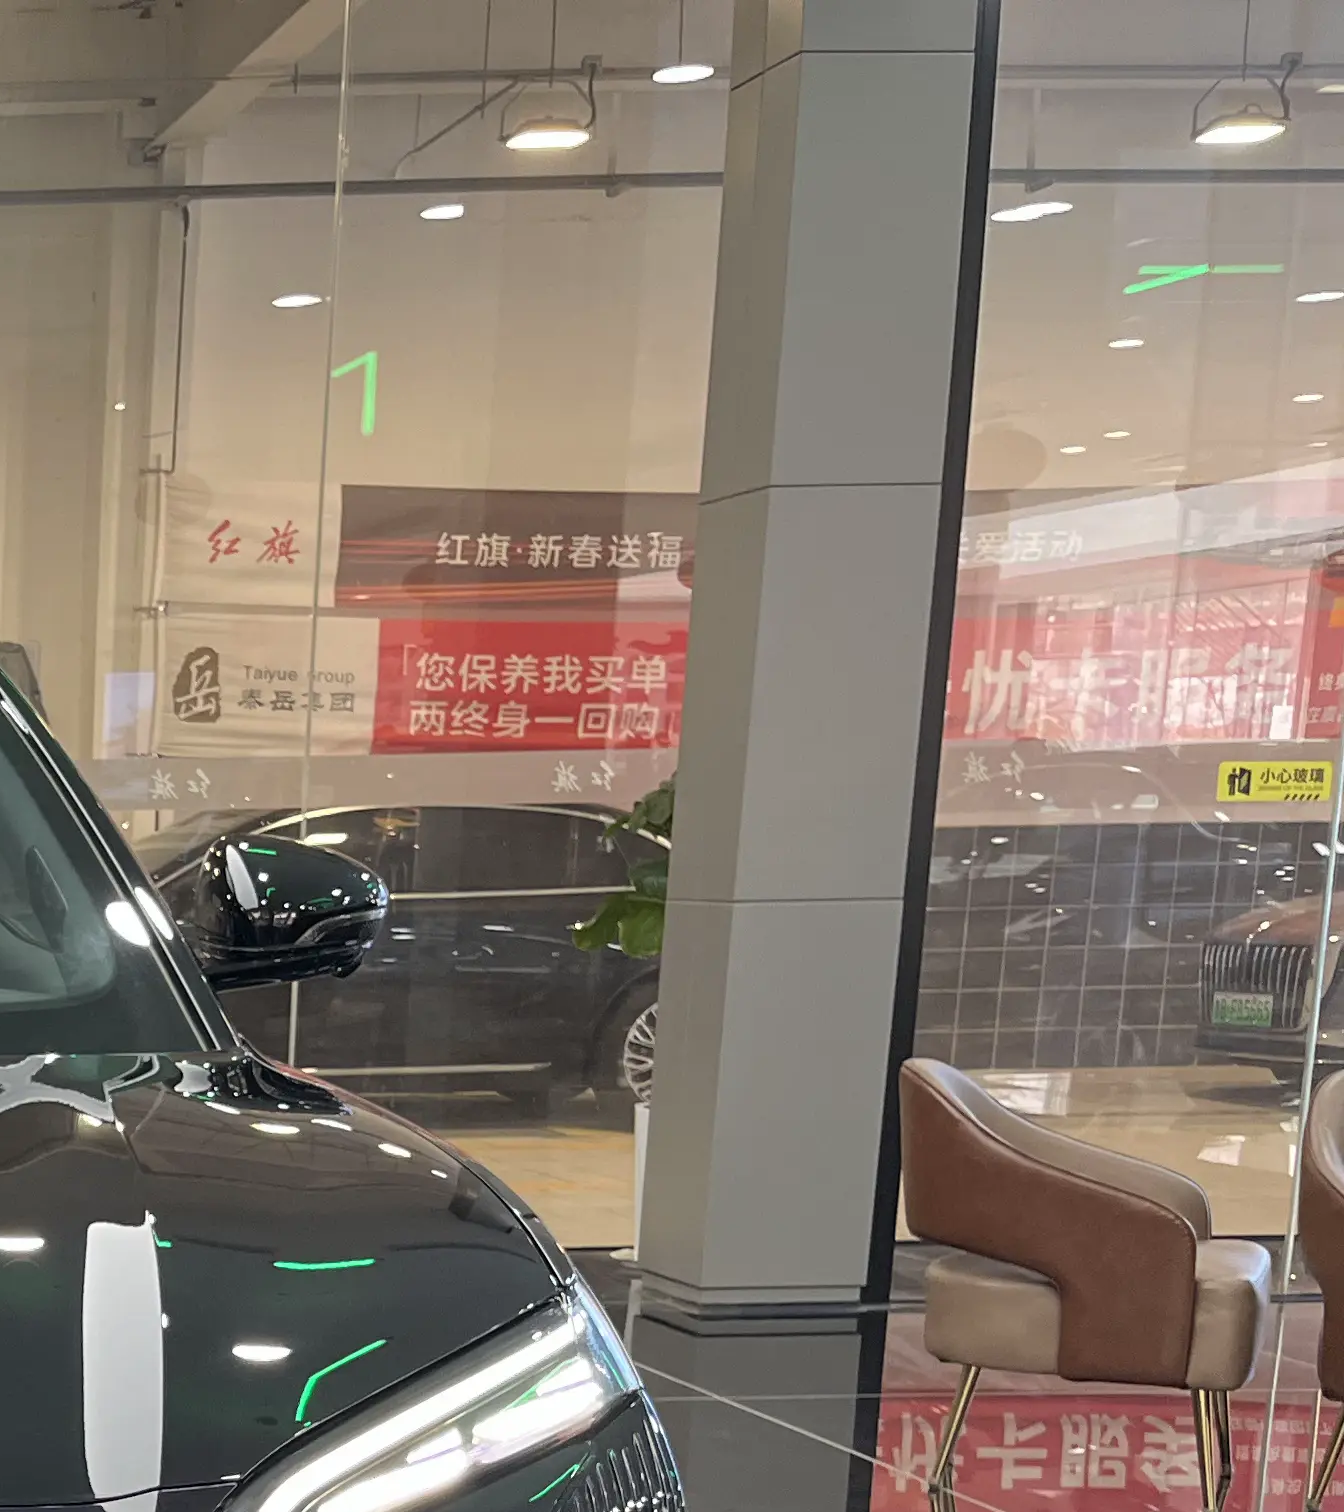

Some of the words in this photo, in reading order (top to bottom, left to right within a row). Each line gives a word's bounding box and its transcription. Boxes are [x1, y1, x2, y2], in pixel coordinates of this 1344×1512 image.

[208, 519, 301, 564] 红旗
[959, 529, 1084, 563] 爱活动
[243, 664, 299, 684] Taiyue
[1260, 767, 1325, 784] 小心玻璃
